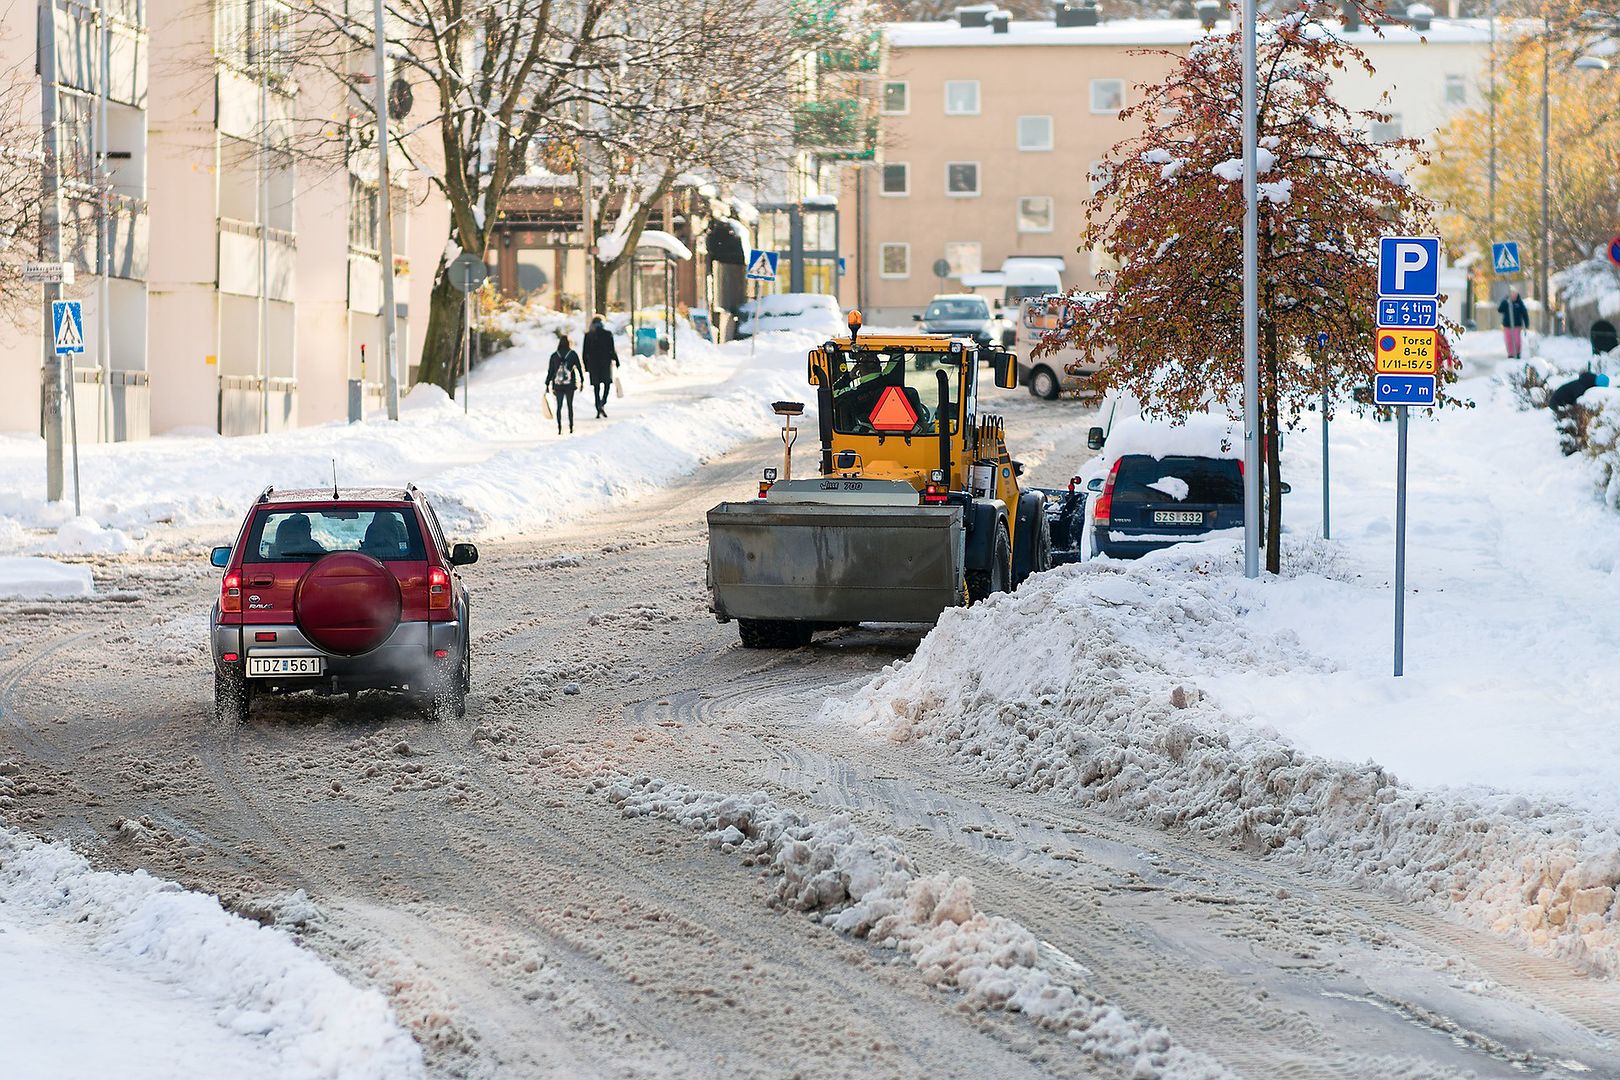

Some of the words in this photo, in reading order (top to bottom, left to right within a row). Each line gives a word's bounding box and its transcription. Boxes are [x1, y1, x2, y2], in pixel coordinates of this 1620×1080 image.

[1395, 243, 1429, 290] P
[1401, 302, 1409, 312] 4
[1413, 302, 1432, 313] tim
[1402, 314, 1431, 325] 9-17
[1402, 336, 1432, 346] Torsd
[1403, 347, 1428, 357] 8-16
[1382, 359, 1433, 369] 1/11-15/5
[1404, 384, 1413, 395] 7
[1418, 386, 1429, 395] m
[844, 481, 863, 490] 700
[1155, 512, 1175, 522] SZS
[1182, 512, 1202, 522] 332
[254, 660, 280, 672] TDZ
[290, 659, 316, 672] 561
